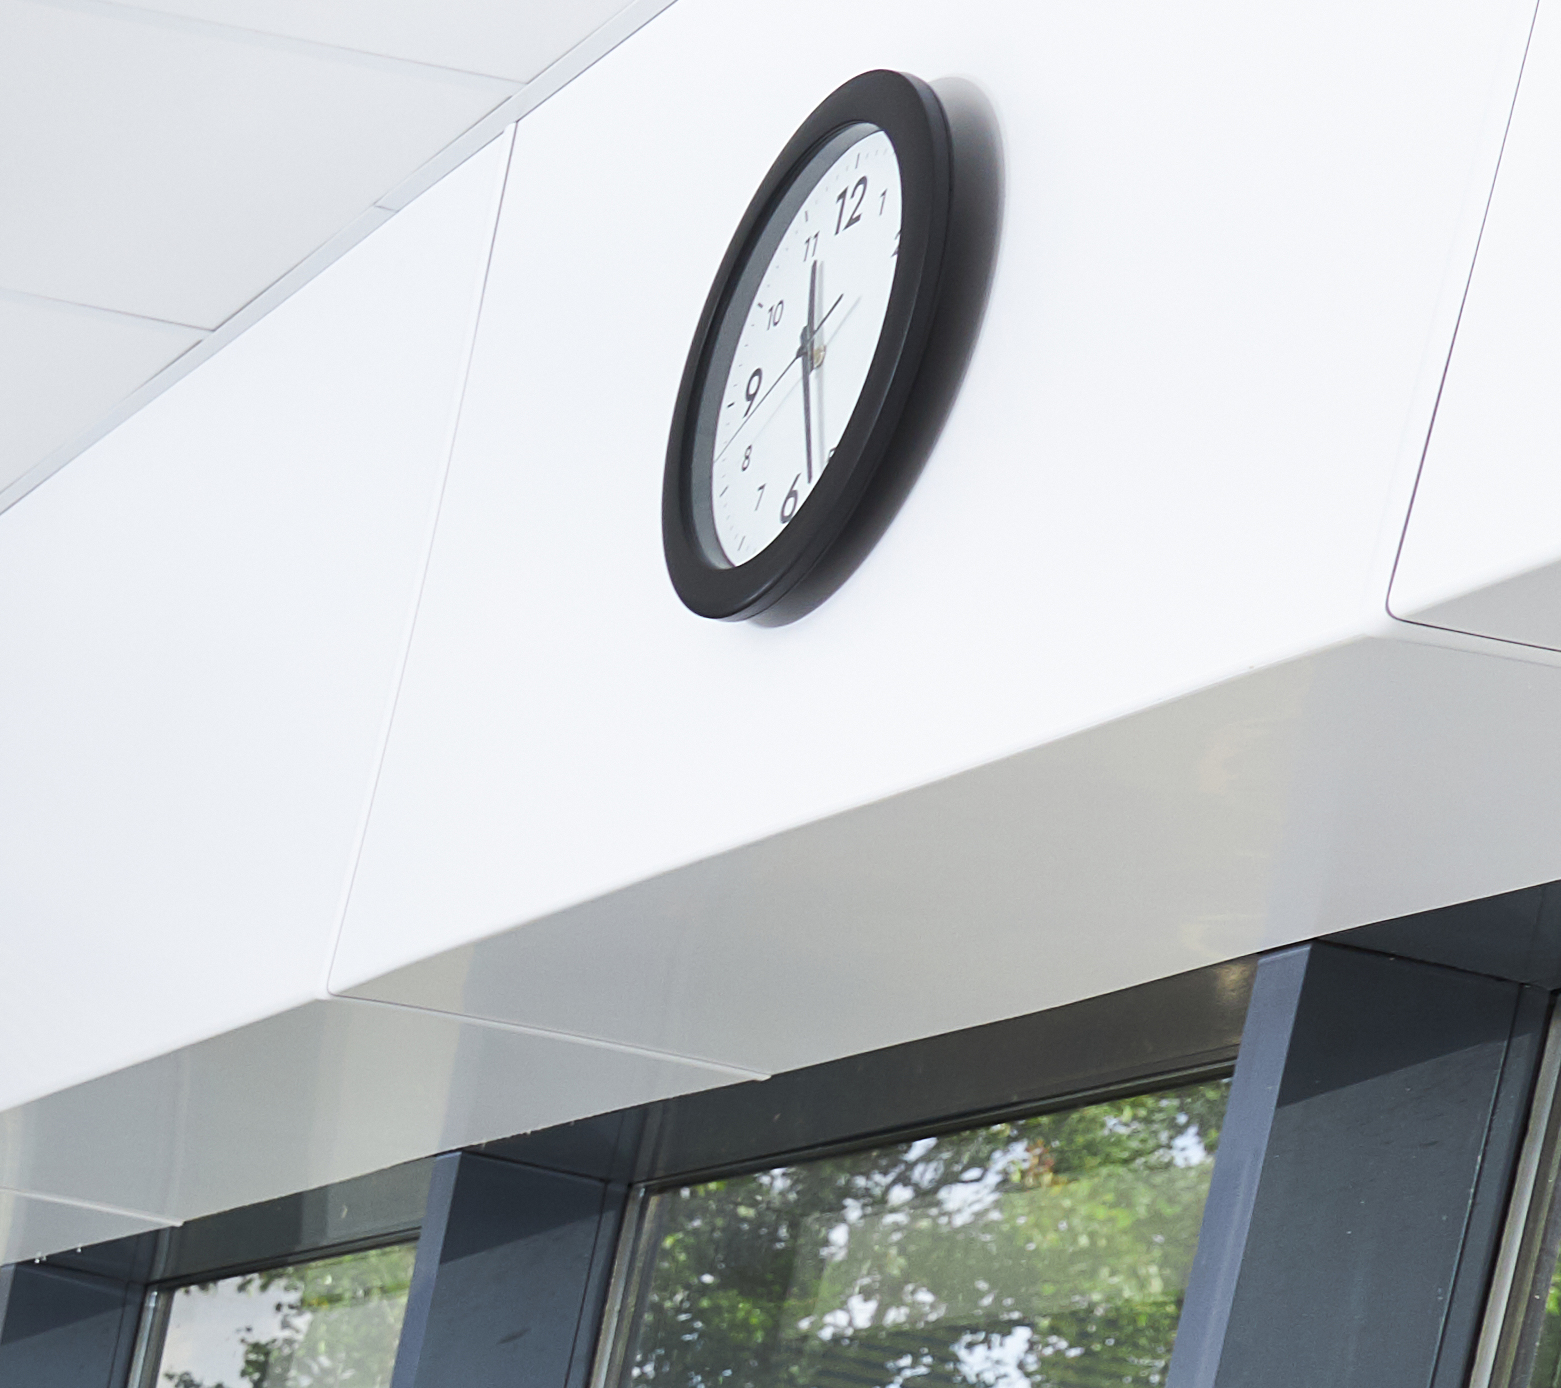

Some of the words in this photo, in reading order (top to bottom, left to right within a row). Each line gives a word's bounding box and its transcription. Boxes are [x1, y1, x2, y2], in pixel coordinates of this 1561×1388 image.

[835, 176, 868, 235] 12
[878, 190, 887, 215] 1
[804, 232, 819, 261] 11
[766, 301, 783, 330] 10
[744, 368, 762, 417] 9
[742, 446, 752, 471] 8
[755, 484, 765, 511] 7
[780, 473, 801, 524] 6
